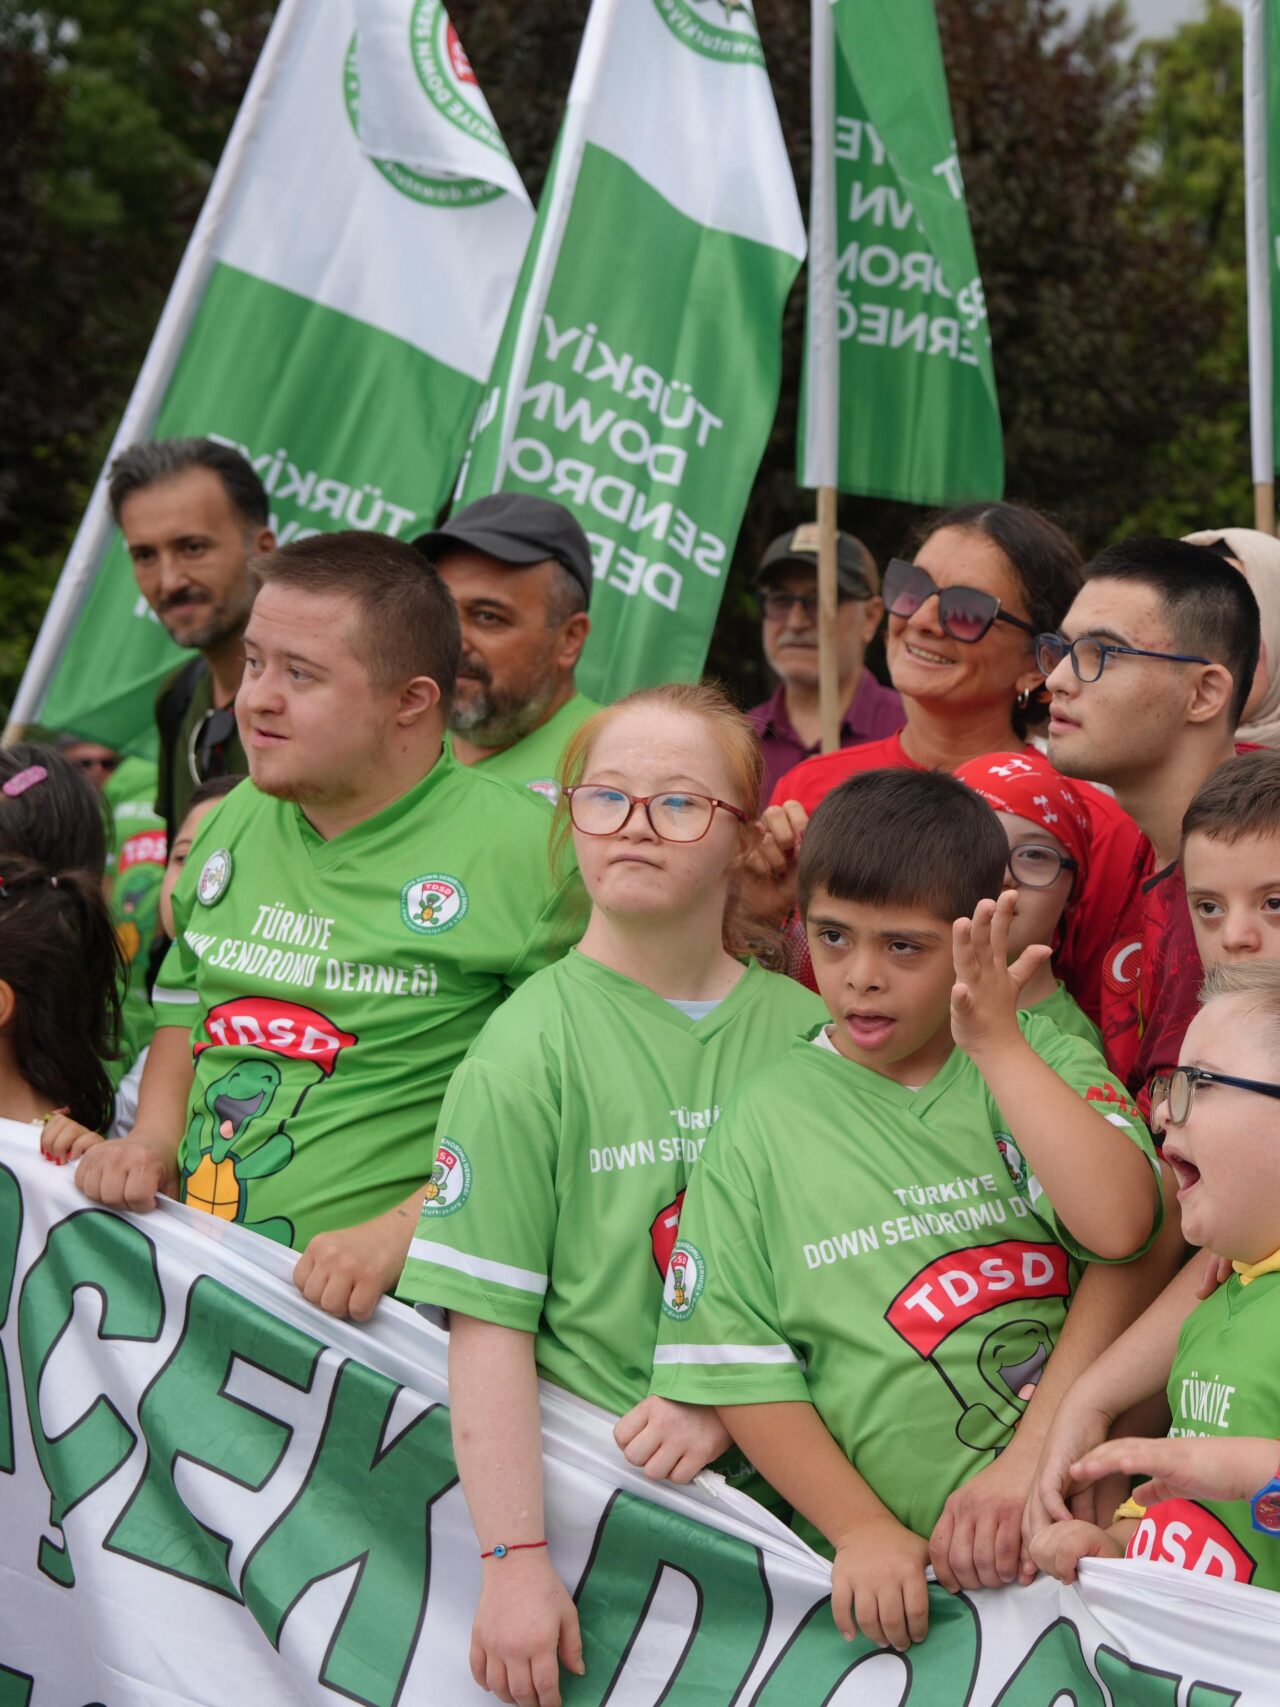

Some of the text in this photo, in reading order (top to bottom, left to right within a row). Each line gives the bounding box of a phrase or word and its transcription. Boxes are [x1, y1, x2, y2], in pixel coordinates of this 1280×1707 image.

[425, 883, 452, 896] TDSD
[250, 902, 335, 951] TÜRKİYE
[208, 938, 320, 988] SENDROMU
[324, 957, 438, 997] DERNEĞİ
[209, 1015, 340, 1054] TDSD
[589, 1138, 656, 1173] DOWN
[892, 1173, 998, 1207] TÜRKİYE
[802, 1225, 880, 1270] DOWN
[880, 1200, 1007, 1246] SENDROMU
[903, 1251, 1055, 1323] TDSD
